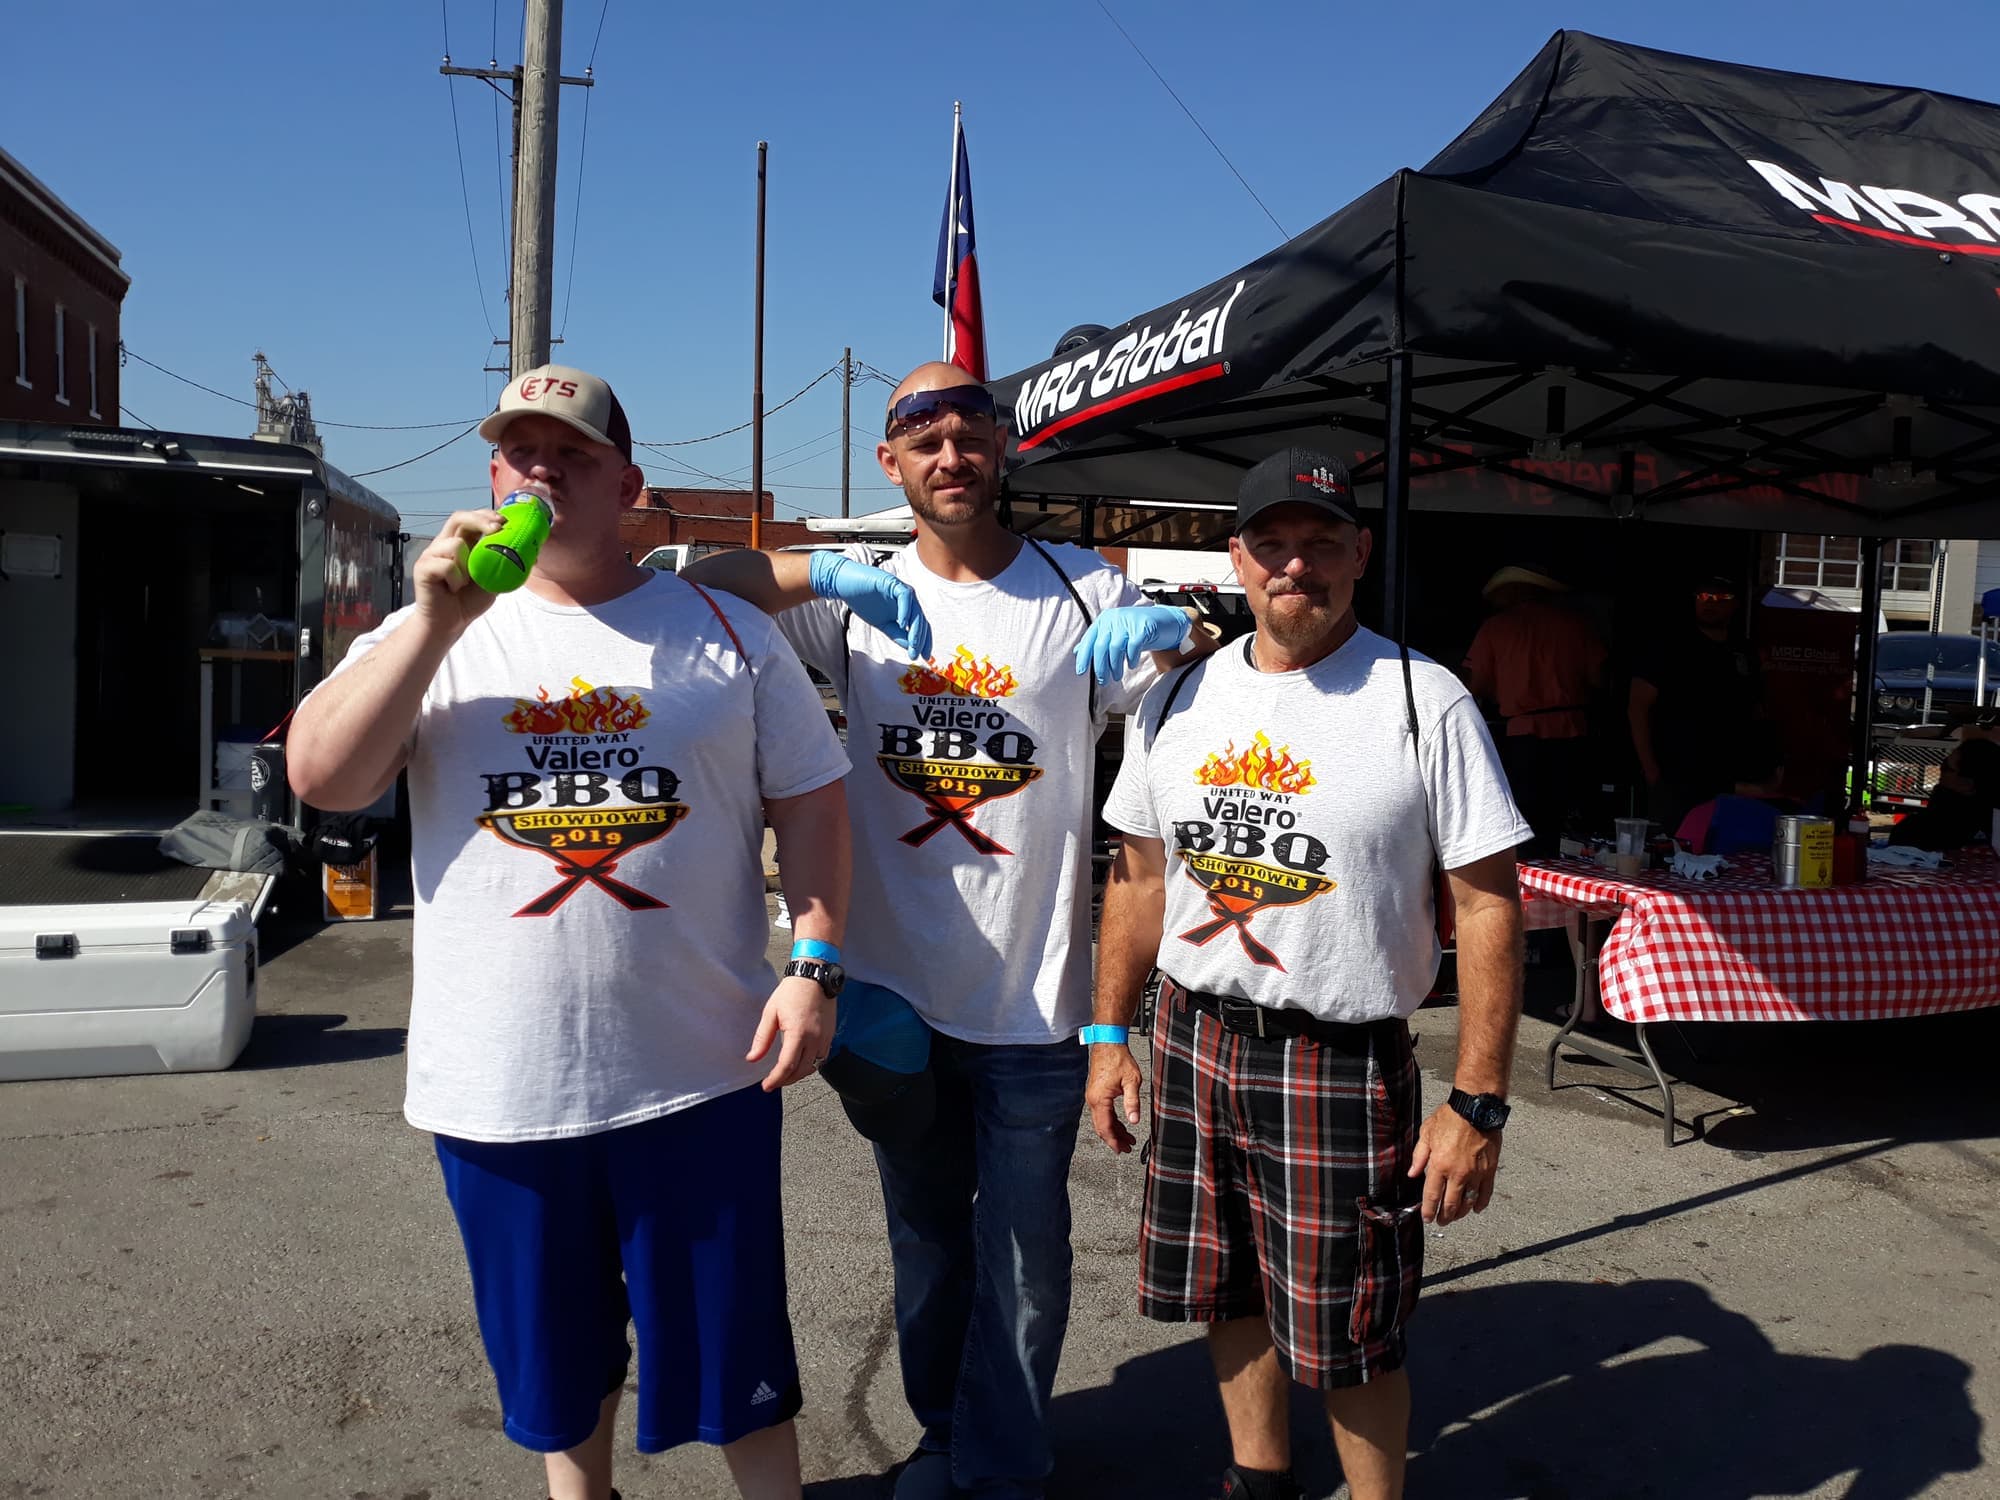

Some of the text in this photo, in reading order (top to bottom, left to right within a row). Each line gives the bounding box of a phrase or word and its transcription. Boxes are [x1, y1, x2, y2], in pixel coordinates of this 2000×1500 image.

[1015, 279, 1246, 436] MRC Global
[919, 696, 1000, 708] UNITED WAY
[912, 705, 1005, 730] Valero
[532, 732, 630, 746] UNITED WAY
[877, 723, 1038, 765] BBQ
[525, 746, 640, 770] Valero
[901, 762, 1015, 781] SHOWDOWN
[480, 766, 682, 812] BBQ
[925, 778, 983, 796] 2019
[1210, 787, 1292, 805] UNITED WAY
[517, 810, 661, 827] SHOWDOWN
[1203, 797, 1296, 829] Valero
[550, 829, 623, 847] 2019
[1172, 820, 1332, 875] BBQ
[1198, 857, 1300, 888] SHOWDOWN
[1210, 877, 1264, 899] 2019
[750, 1391, 777, 1406] adidas
